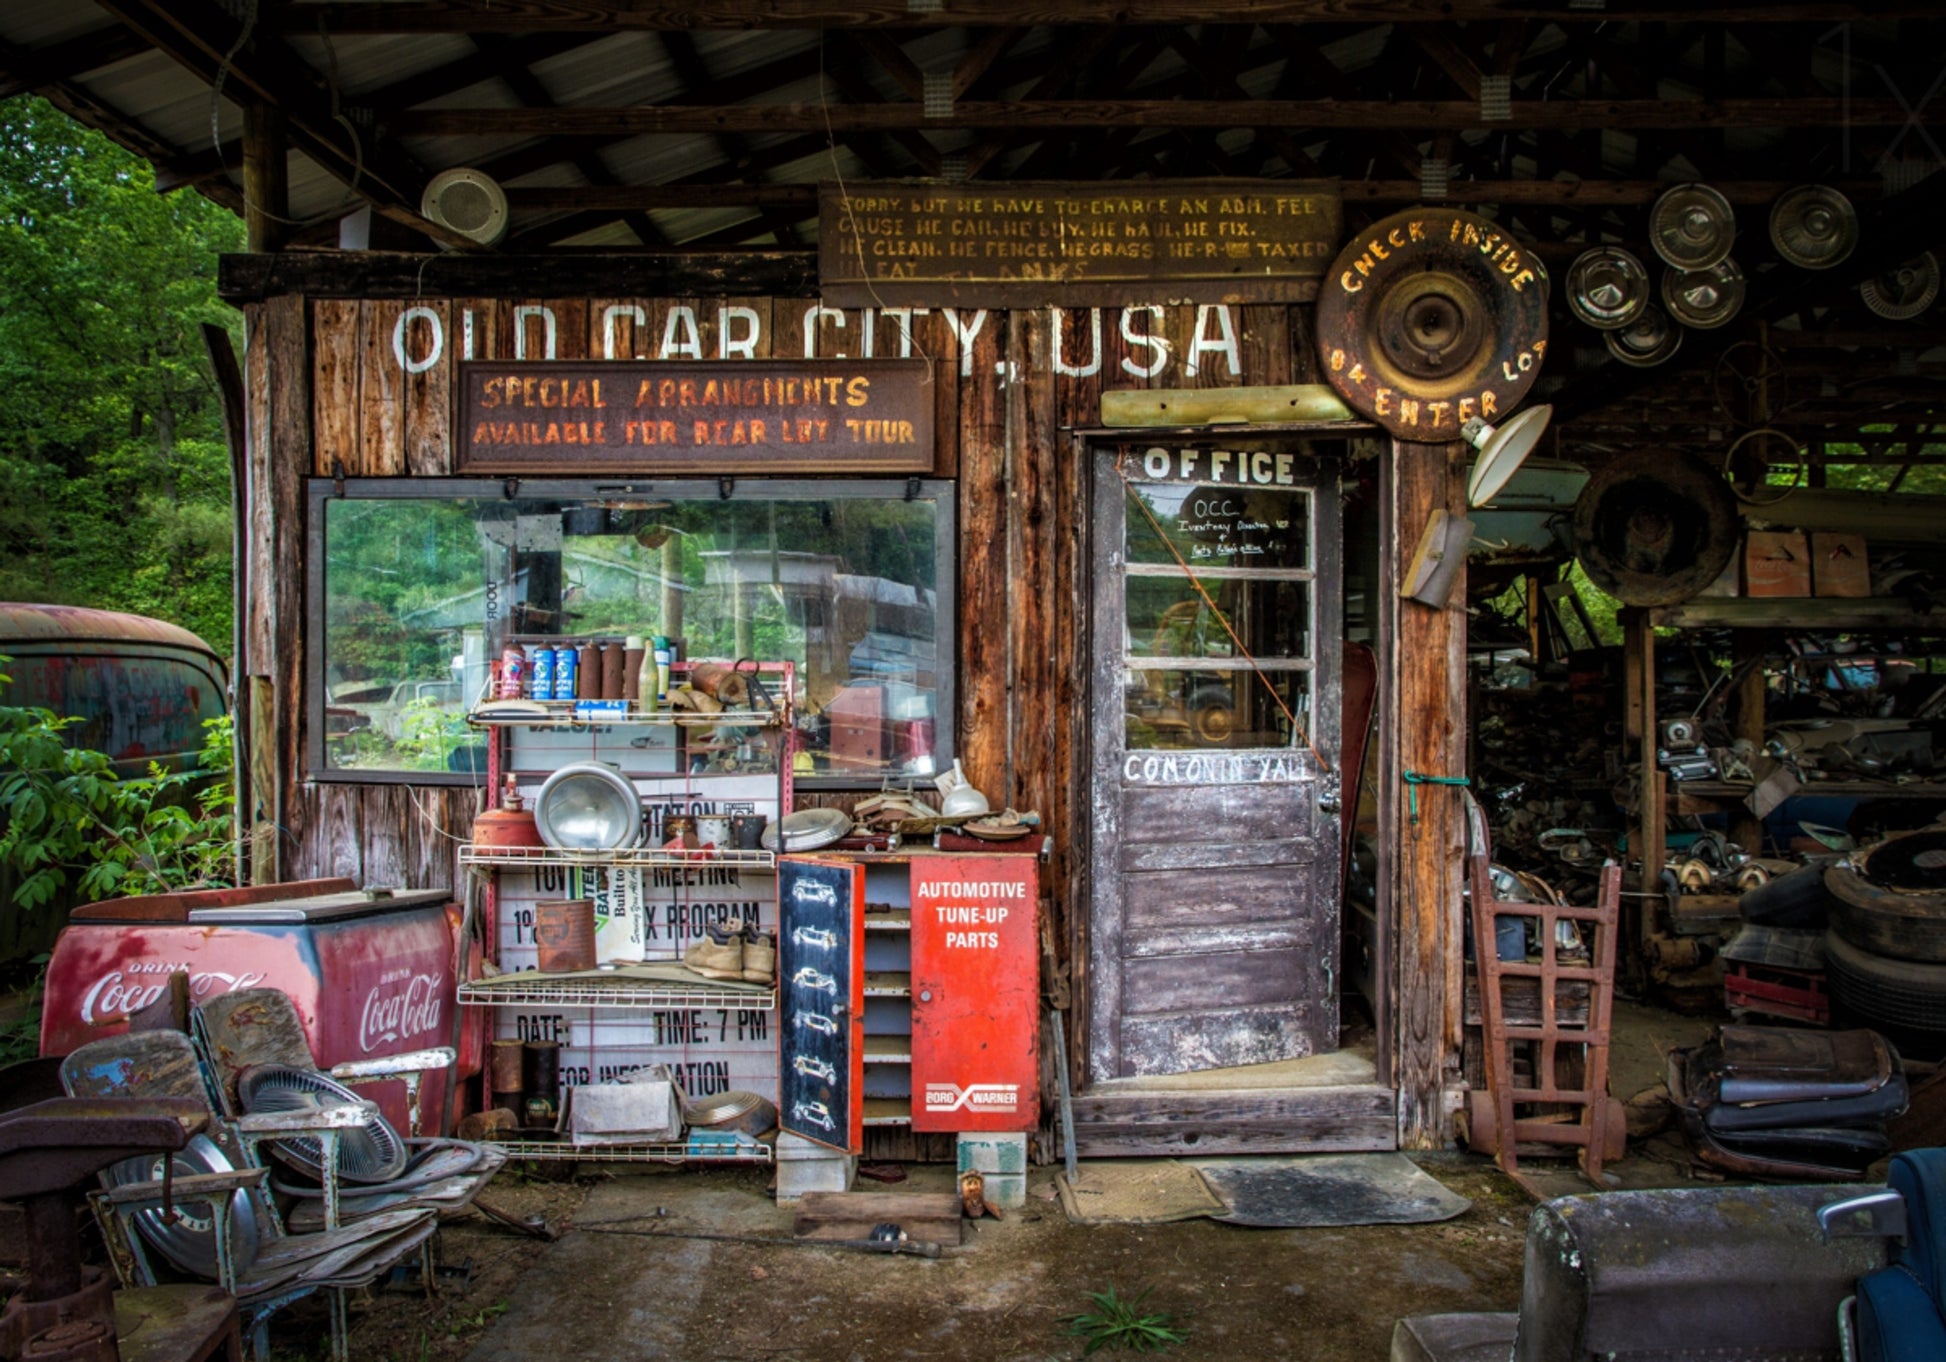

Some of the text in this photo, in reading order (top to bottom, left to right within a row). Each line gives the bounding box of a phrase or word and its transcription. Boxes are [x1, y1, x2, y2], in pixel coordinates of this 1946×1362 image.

[1276, 199, 1317, 215] FEE
[1341, 221, 1426, 293] CHECK
[603, 304, 761, 360] CAR
[1052, 304, 1242, 379] USA
[480, 376, 607, 408] SPECIAL
[1375, 387, 1498, 428] ENTER
[473, 419, 915, 446] AVAILABLE FOR REAR LOT TOUR
[1144, 447, 1294, 484] OFFICE
[613, 868, 626, 917] Built to
[917, 881, 1026, 898] AUTOMOTIVE
[936, 907, 1009, 923] TUNE-UP
[945, 932, 998, 949] PARTS
[128, 962, 191, 974] DRINK
[653, 1010, 709, 1045] TIME:
[717, 1009, 728, 1042] 7
[737, 1009, 768, 1041] PM
